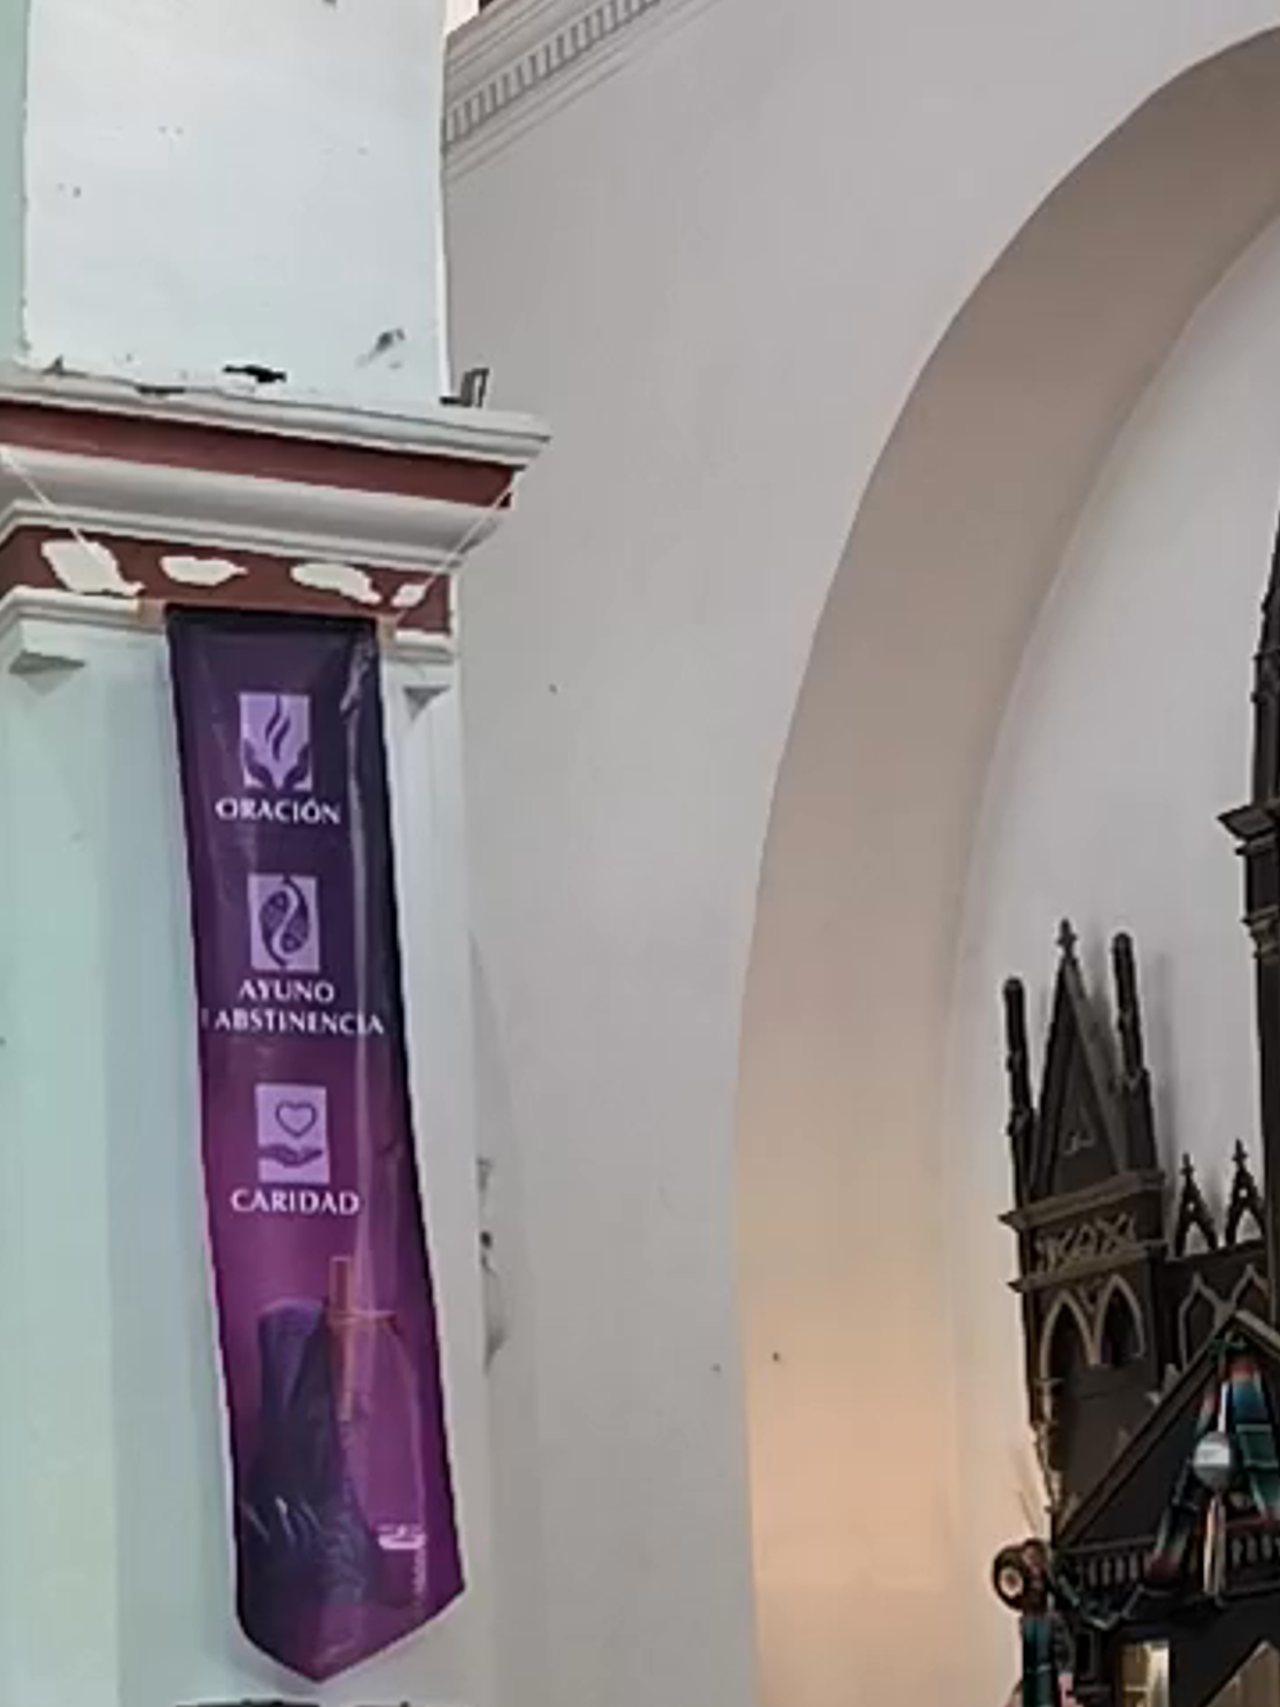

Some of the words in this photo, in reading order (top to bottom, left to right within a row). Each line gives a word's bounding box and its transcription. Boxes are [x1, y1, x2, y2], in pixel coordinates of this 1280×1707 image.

[215, 797, 341, 824] ORACIÓN
[239, 979, 335, 1002] AYUNO
[215, 1007, 385, 1035] ABSTINENCIA
[230, 1188, 361, 1216] CARIDAD
